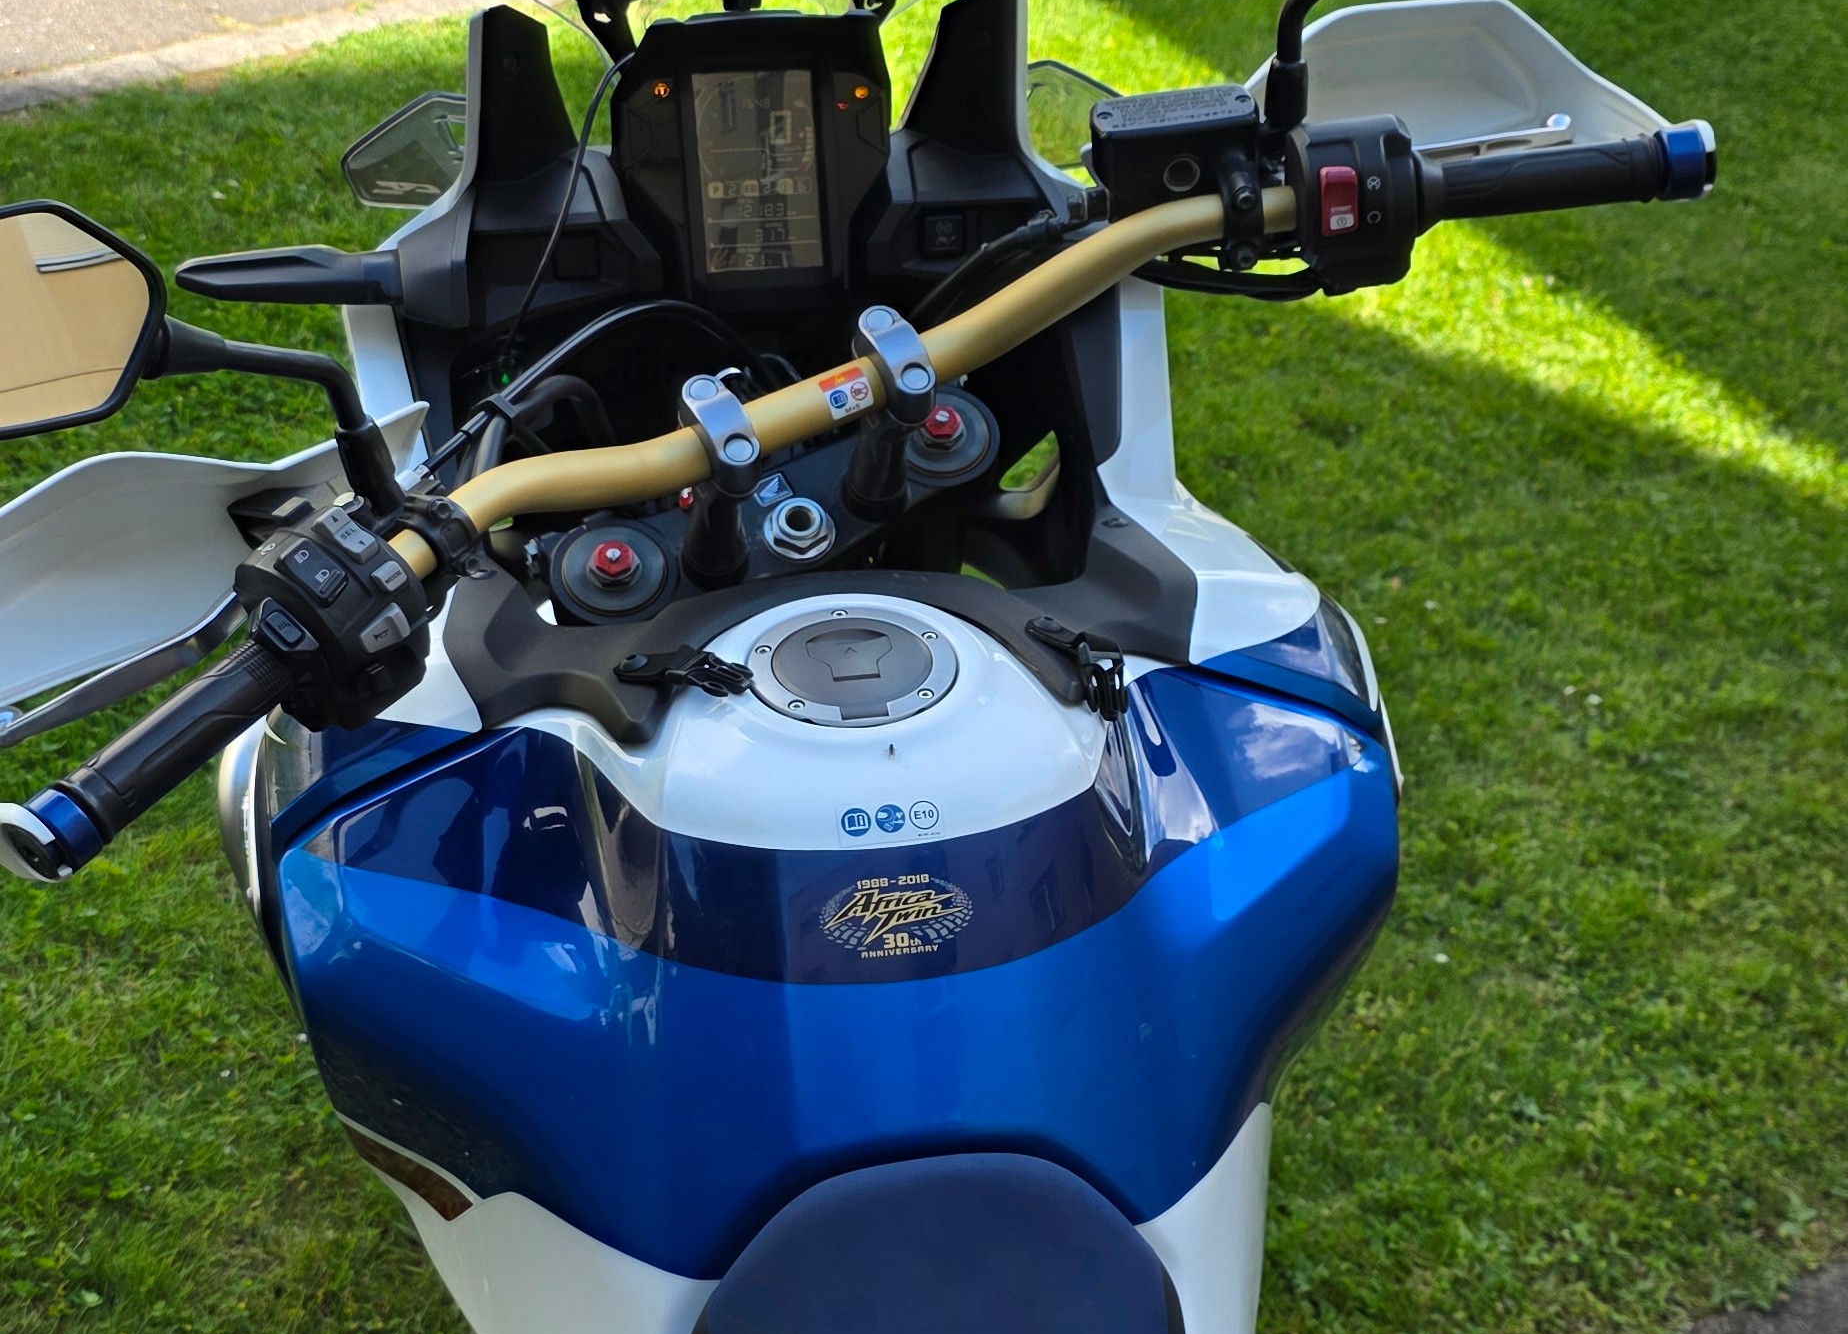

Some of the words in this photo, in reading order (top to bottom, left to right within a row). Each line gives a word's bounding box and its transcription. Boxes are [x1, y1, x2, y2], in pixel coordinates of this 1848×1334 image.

[341, 527, 356, 540] SEL
[914, 810, 934, 820] E10
[863, 902, 966, 947] Twin
[882, 932, 922, 949] 30th
[861, 944, 939, 959] ANNIVERSARY
